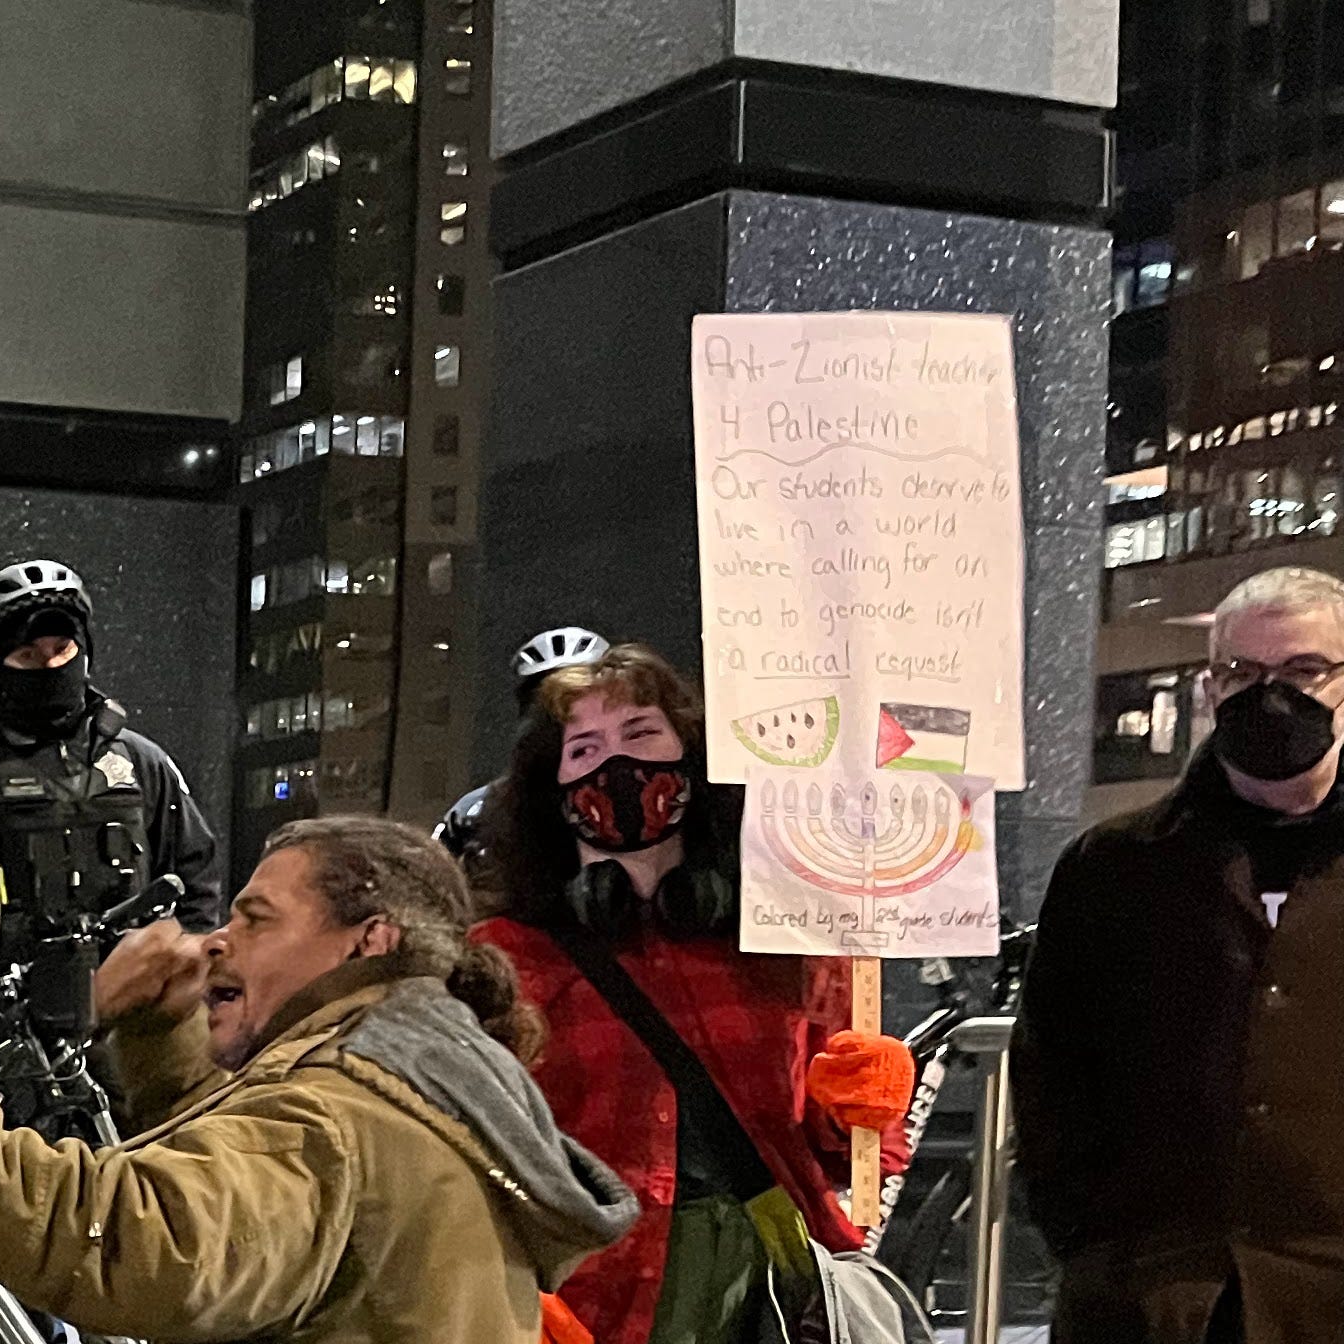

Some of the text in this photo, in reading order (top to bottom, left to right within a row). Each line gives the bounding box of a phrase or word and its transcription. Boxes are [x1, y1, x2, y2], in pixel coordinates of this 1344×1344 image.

[720, 400, 919, 443] 4 Palestine
[712, 464, 767, 500] Our
[779, 466, 883, 499] students
[714, 508, 957, 541] live in a world
[713, 550, 793, 579] where
[811, 547, 891, 589] calling
[904, 541, 939, 576] for
[780, 599, 799, 628] to
[819, 601, 917, 637] genocide
[727, 647, 747, 672] a
[760, 640, 851, 673] radical
[753, 904, 808, 928] Colored
[816, 904, 833, 934] by
